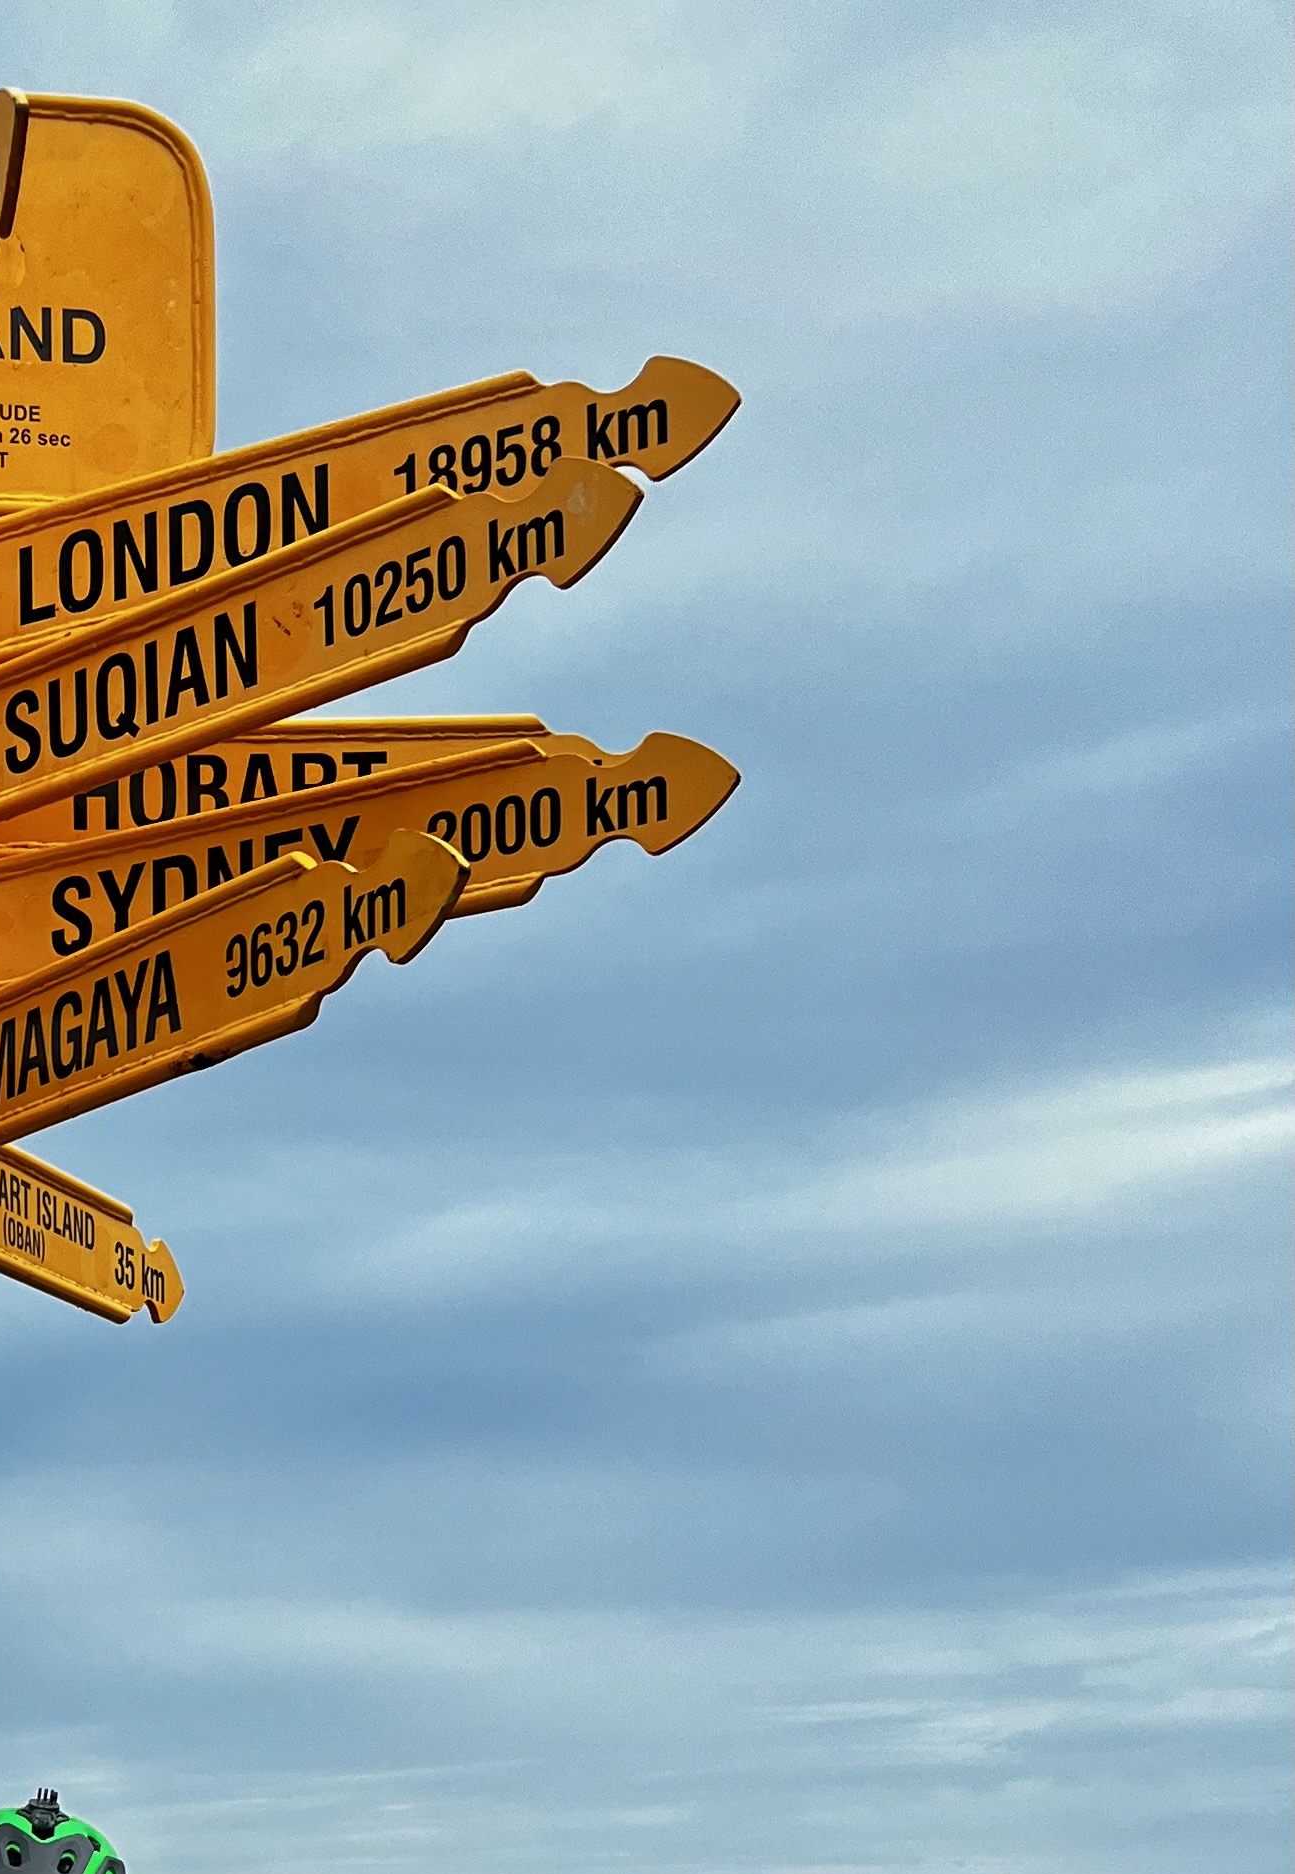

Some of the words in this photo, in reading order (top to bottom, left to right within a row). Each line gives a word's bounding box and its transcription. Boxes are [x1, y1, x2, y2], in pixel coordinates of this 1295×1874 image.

[10, 428, 31, 444] 26
[38, 433, 71, 447] sec
[17, 463, 330, 626] LONDON
[393, 415, 562, 495] 18958
[586, 399, 668, 460] km
[3, 602, 259, 775] SUQIAN
[314, 535, 467, 648] 10250
[488, 508, 565, 584] km
[586, 775, 668, 837] km
[225, 899, 325, 999] 9632
[343, 876, 406, 951] km
[3, 1212, 45, 1263] (OBAN)
[36, 1187, 95, 1250] ISLAND
[114, 1241, 135, 1290] 35
[141, 1253, 165, 1305] km
